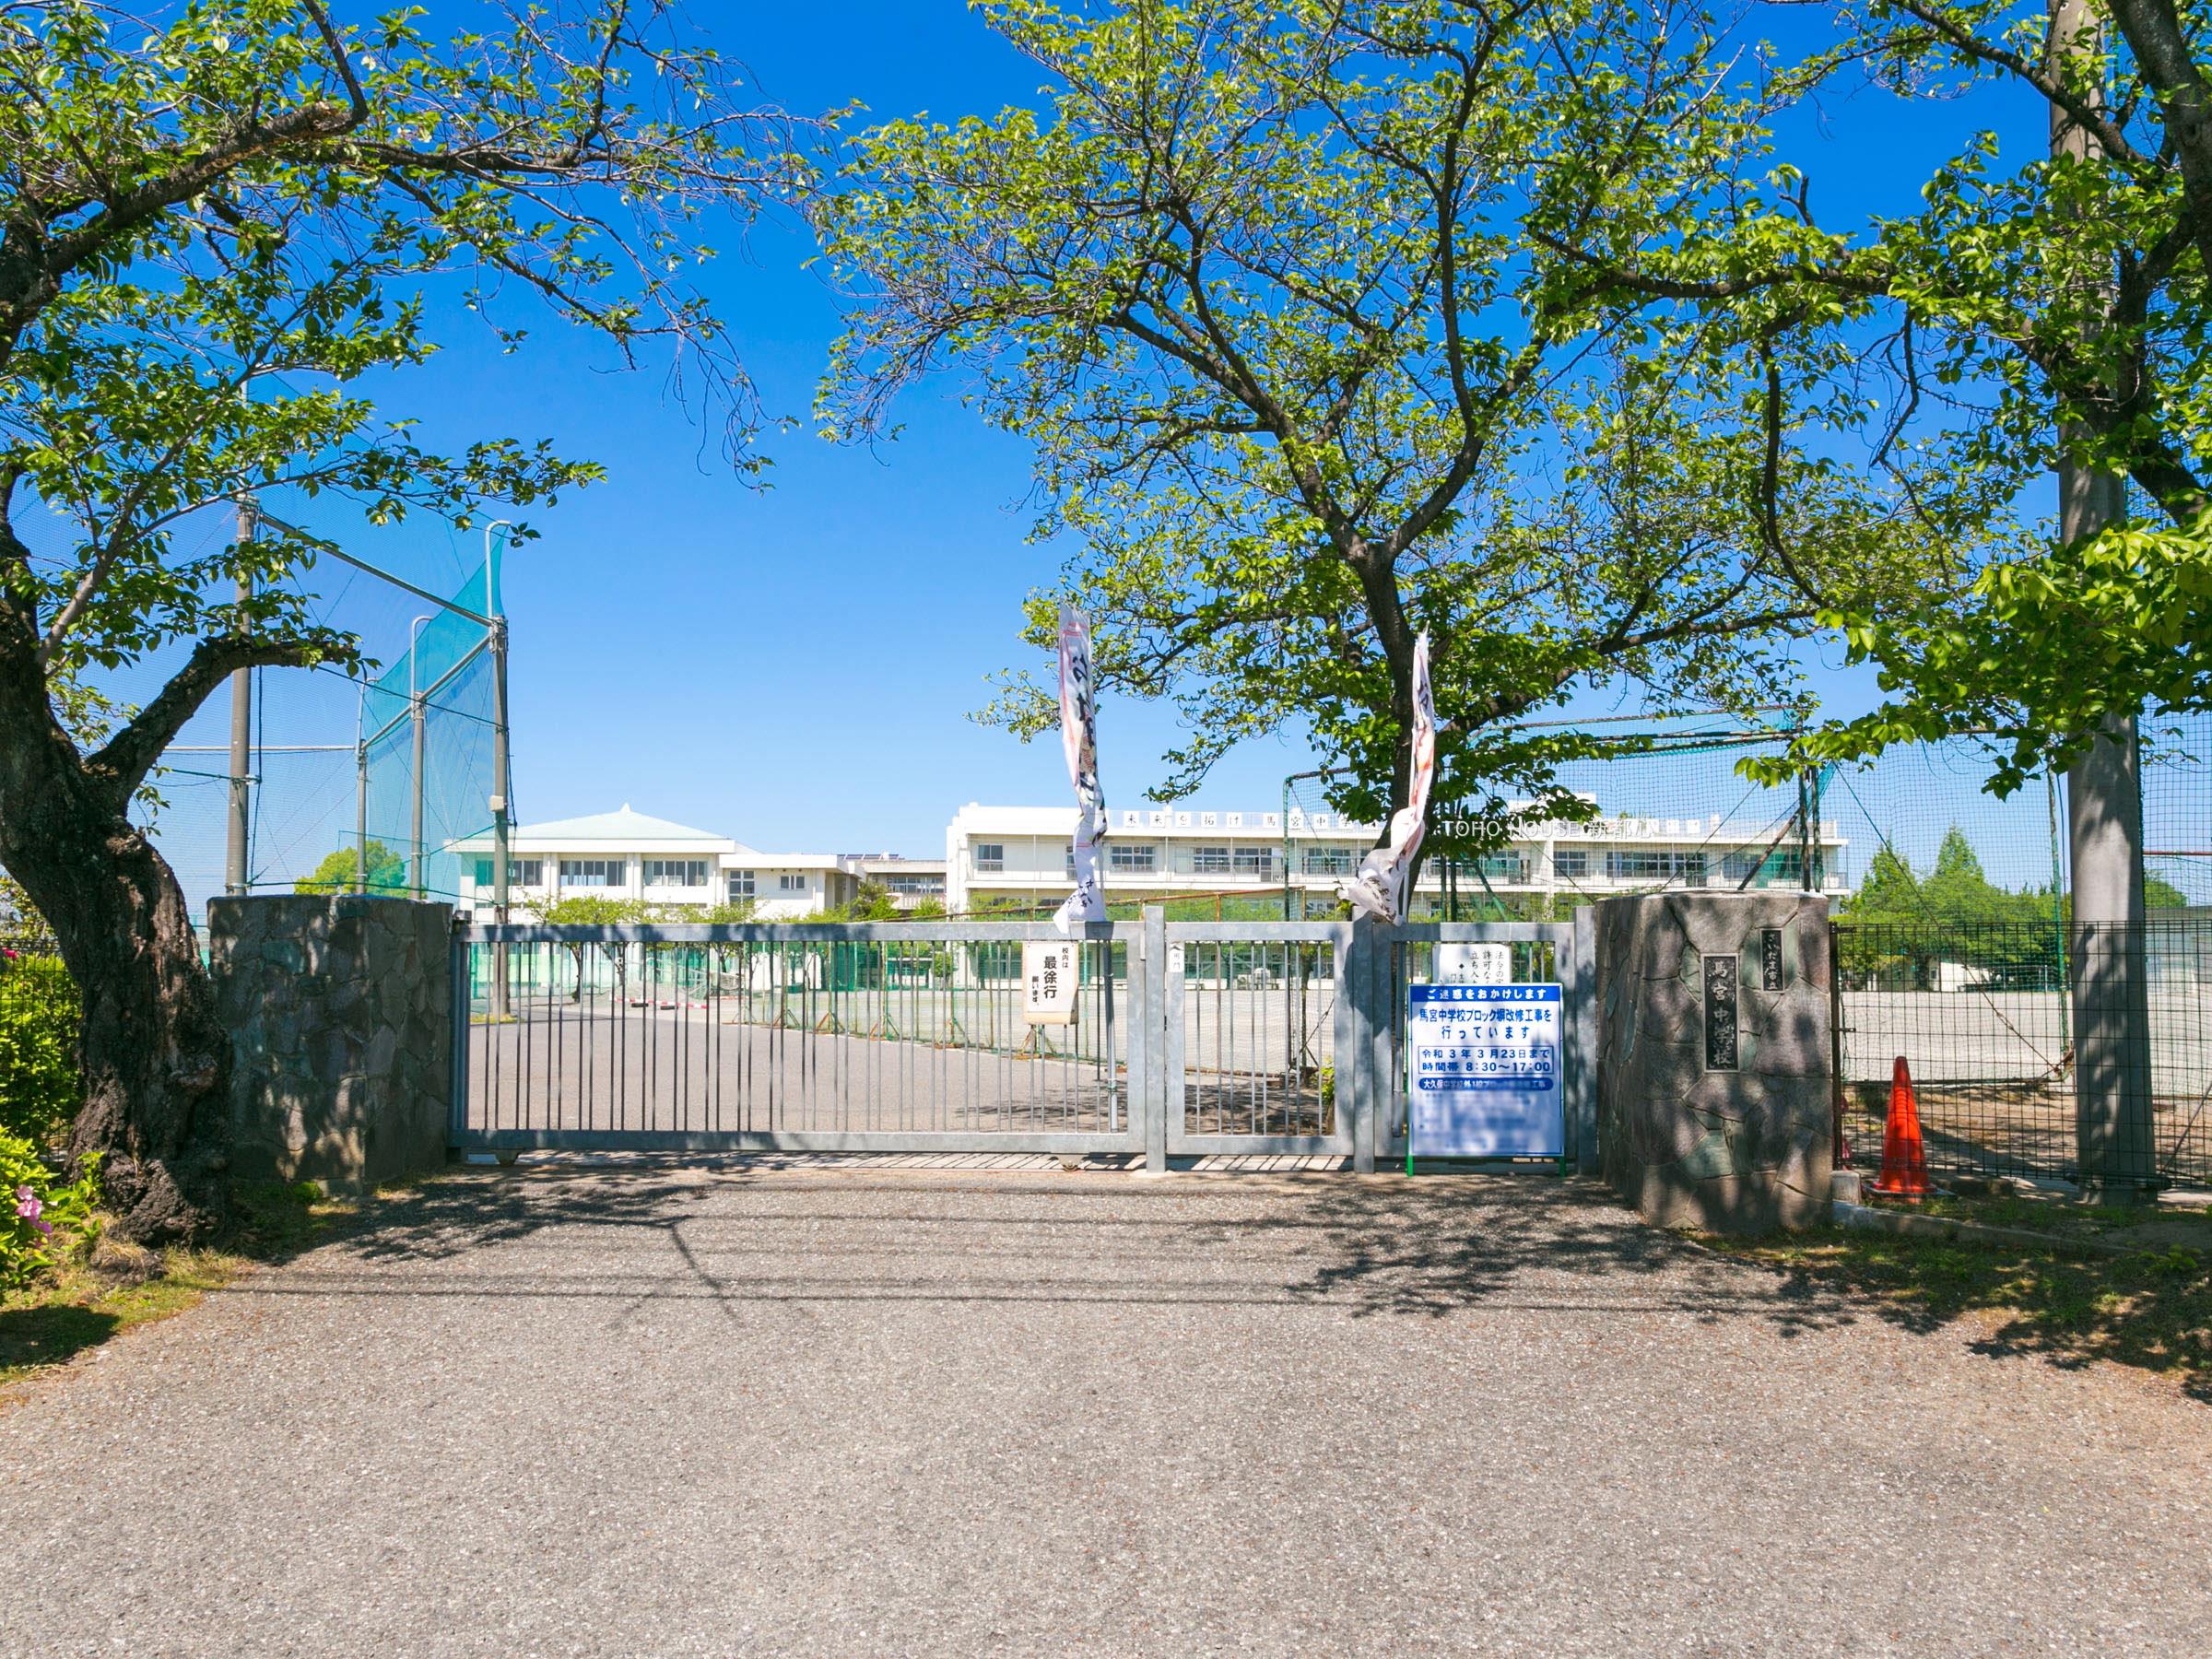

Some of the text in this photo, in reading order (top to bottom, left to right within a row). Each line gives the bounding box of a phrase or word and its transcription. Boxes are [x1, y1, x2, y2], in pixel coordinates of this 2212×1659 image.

[1043, 955, 1058, 999] 最徐行
[1427, 988, 1547, 1000] ご迷惑をおかけします
[1419, 1008, 1552, 1023] 馬宮中学校ブロック塀改修工事を
[1712, 960, 1732, 1066] 馬宮中学校
[1441, 1025, 1531, 1040] 行っています
